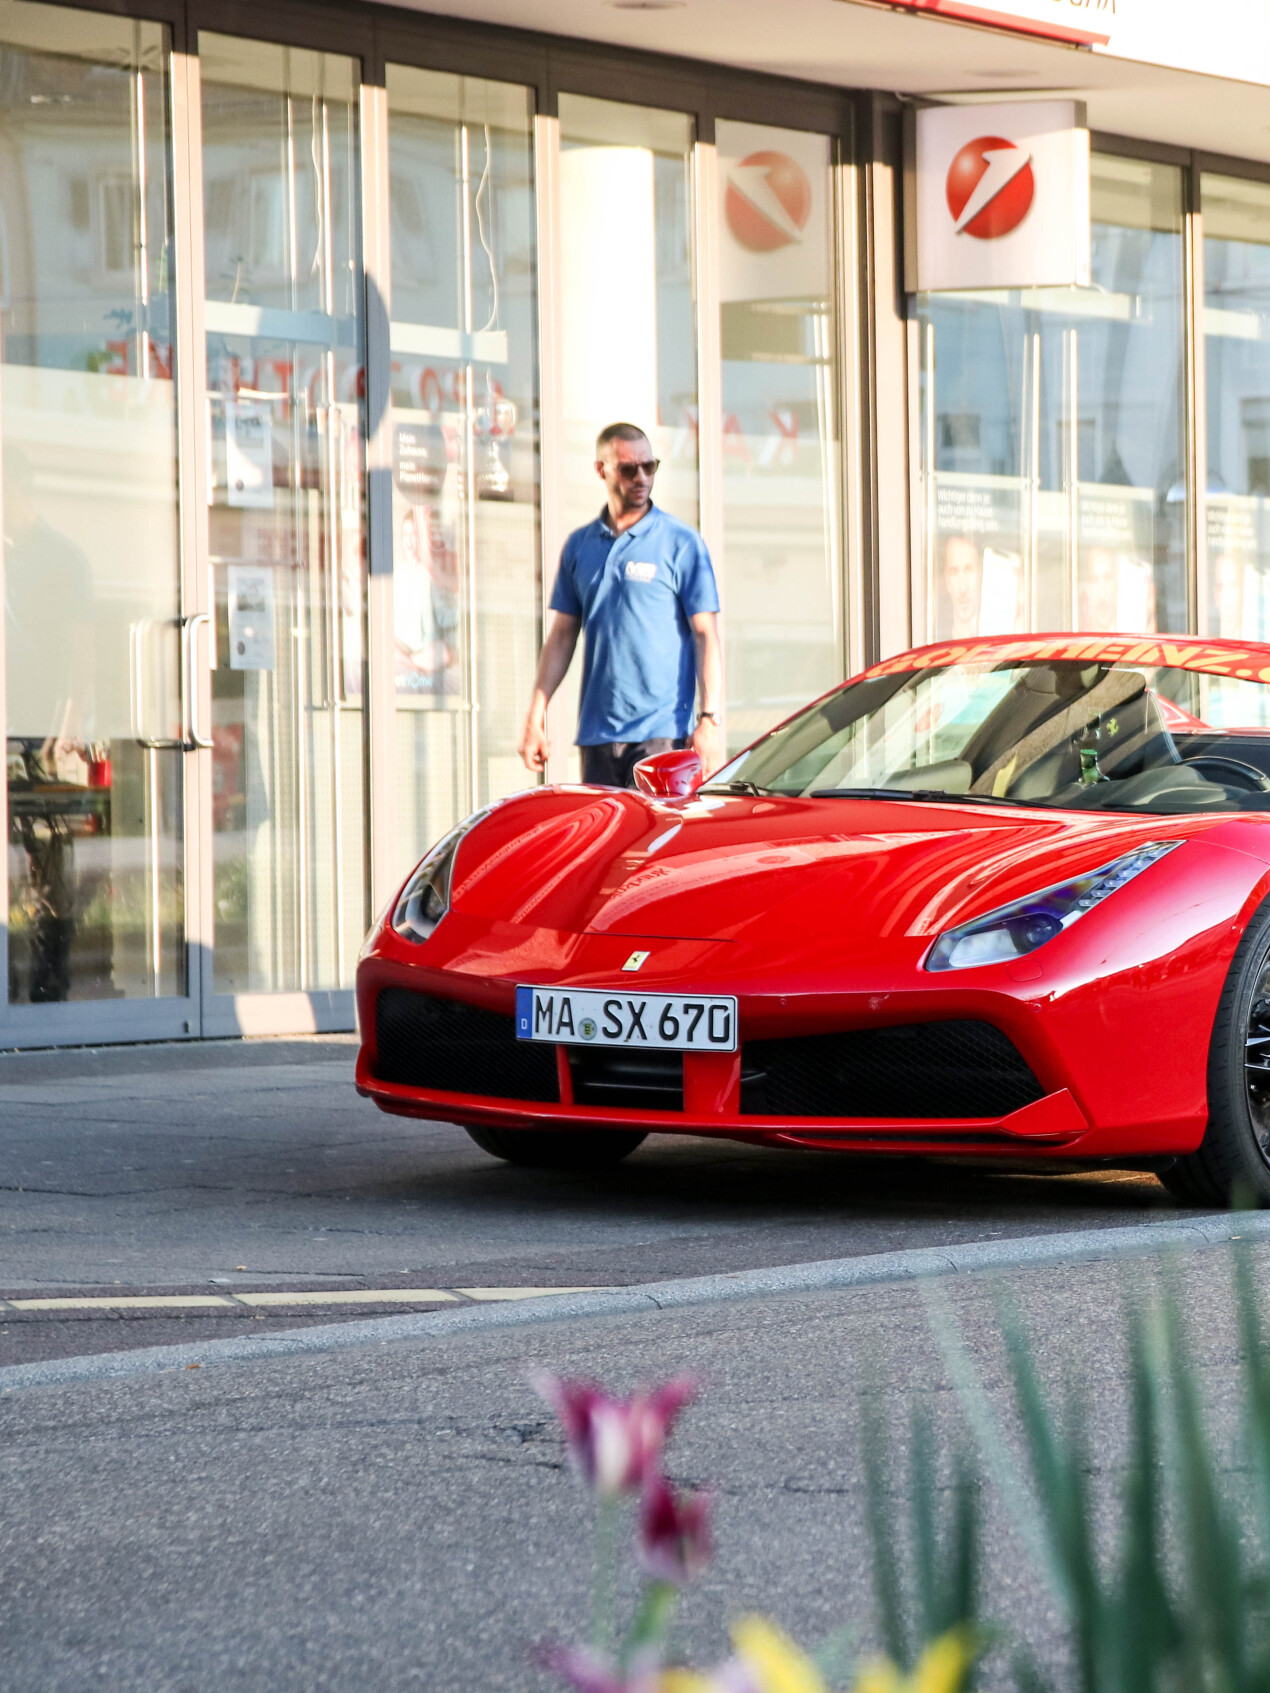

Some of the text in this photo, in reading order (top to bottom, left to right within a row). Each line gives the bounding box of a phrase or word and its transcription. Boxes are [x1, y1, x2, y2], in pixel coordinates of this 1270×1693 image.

[520, 1018, 528, 1030] D
[535, 994, 730, 1043] MA SX 670
